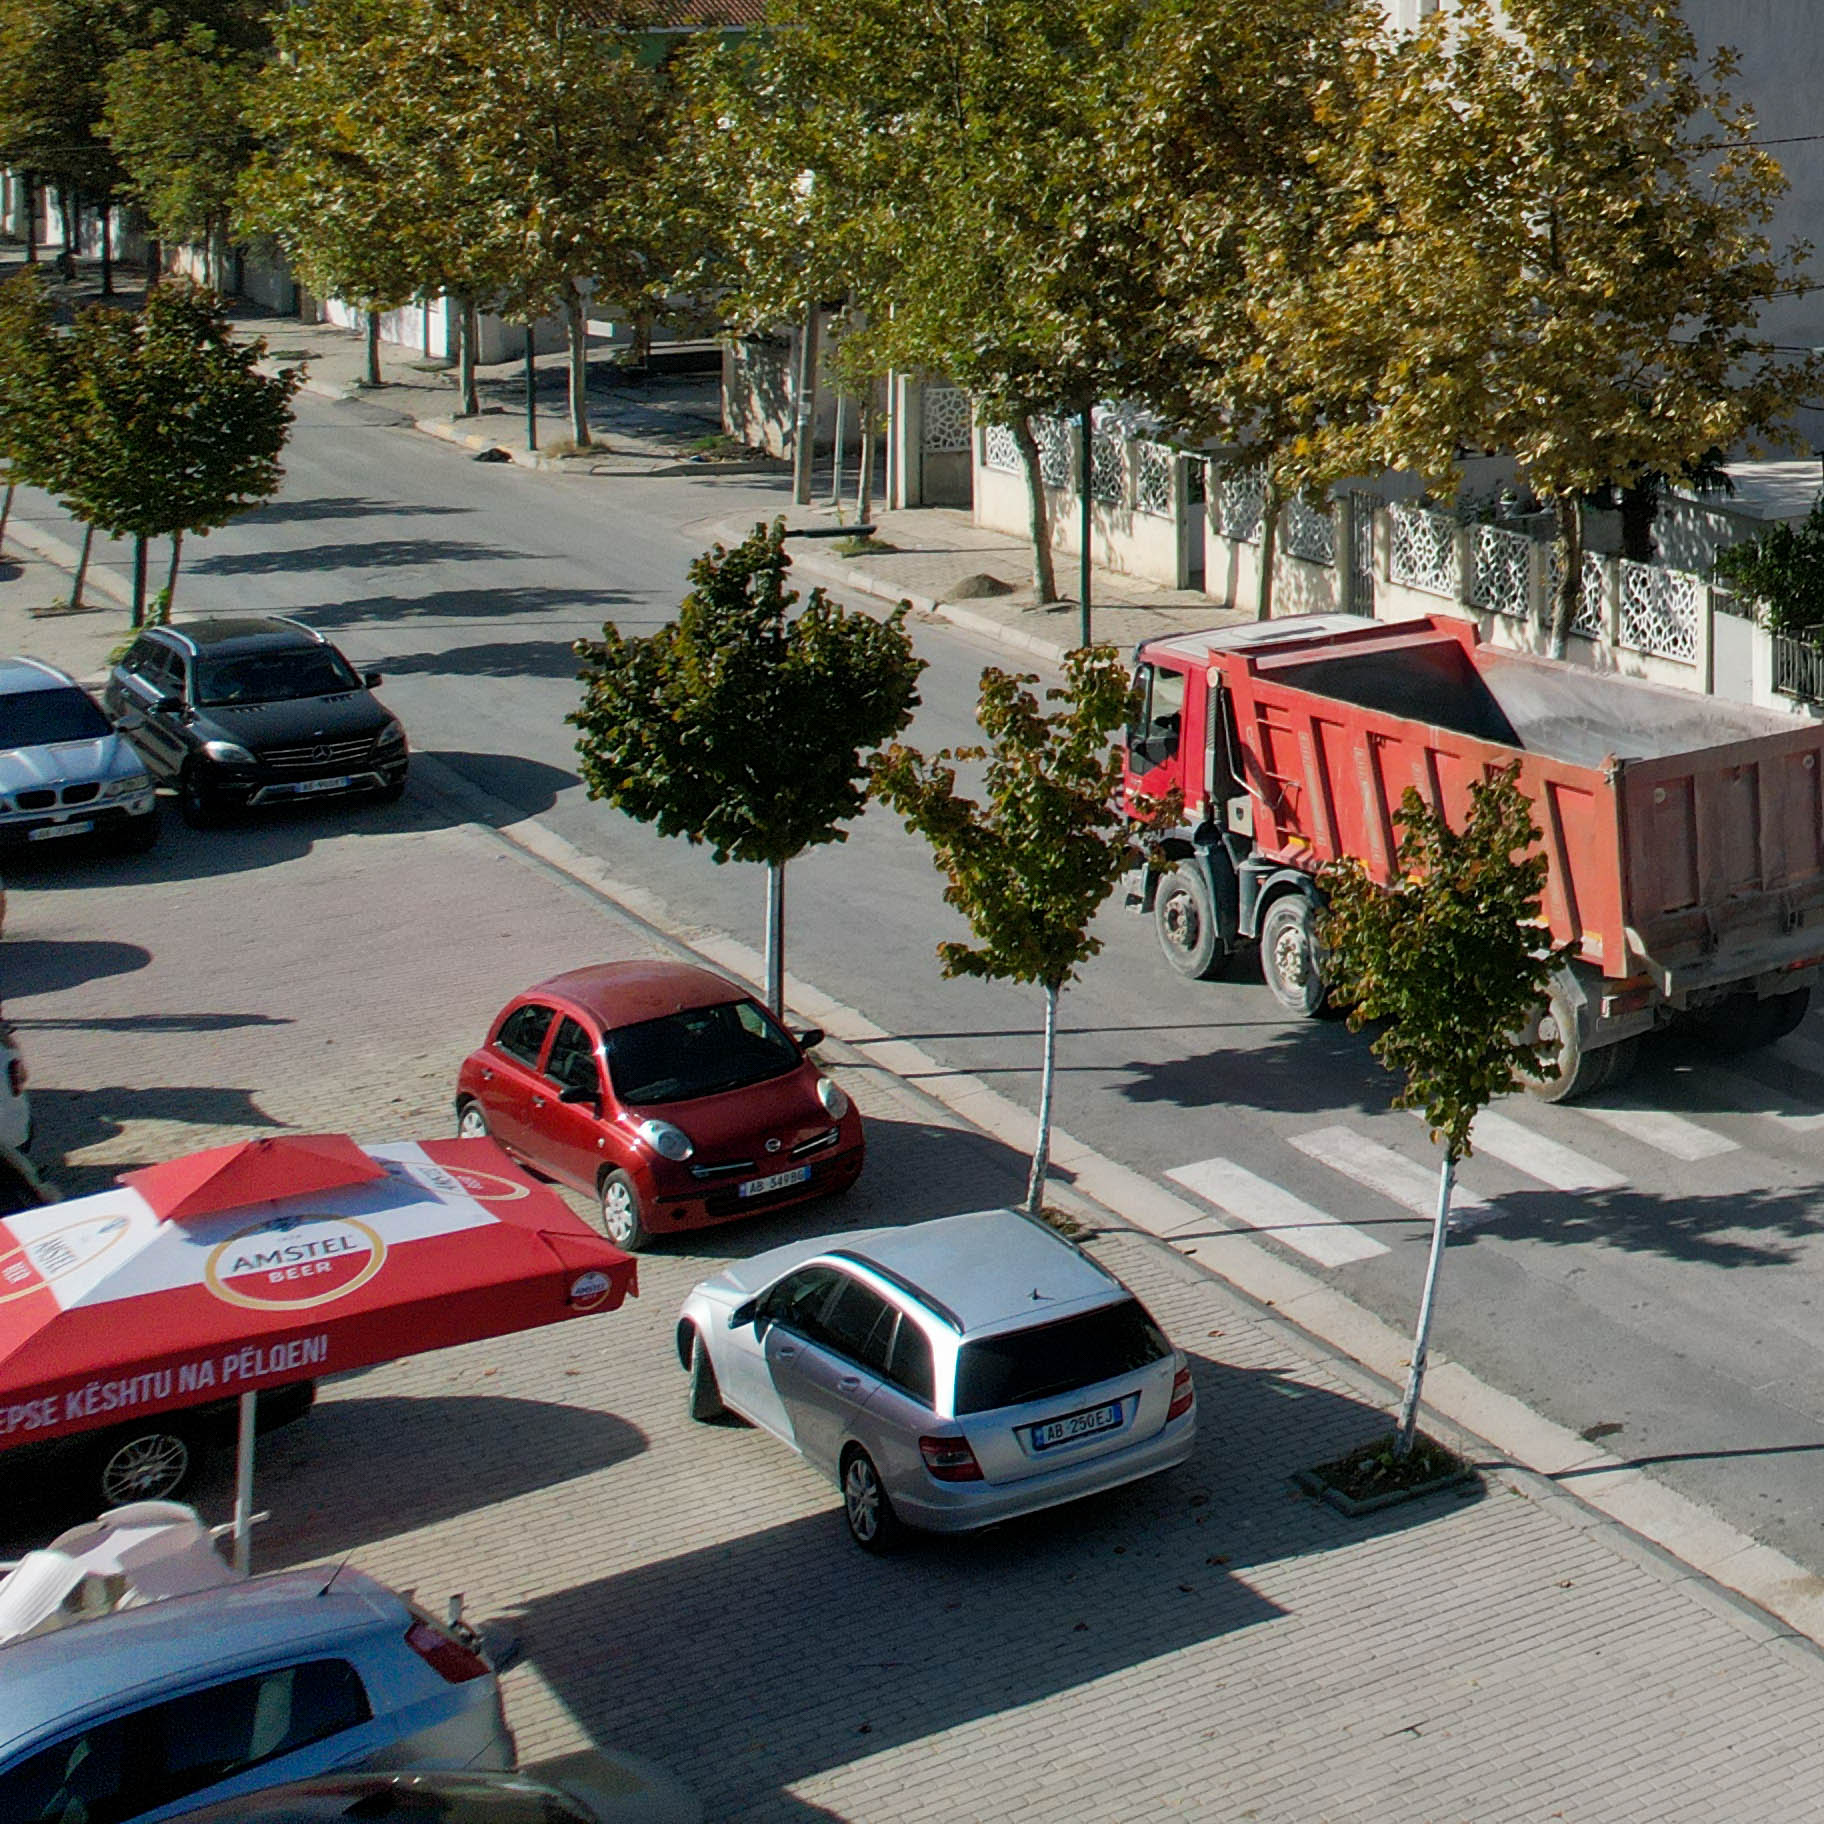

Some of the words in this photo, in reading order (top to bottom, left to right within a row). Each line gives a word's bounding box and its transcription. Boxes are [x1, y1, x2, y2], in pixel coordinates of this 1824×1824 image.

[232, 1235, 358, 1273] AMSTEL
[267, 1261, 332, 1284] BEER
[65, 1368, 172, 1421] KËSHTU
[178, 1362, 217, 1393] NA
[221, 1333, 329, 1383] PËLQEN!
[1047, 1424, 1063, 1441] AB
[1070, 1407, 1112, 1434] 250EJ
